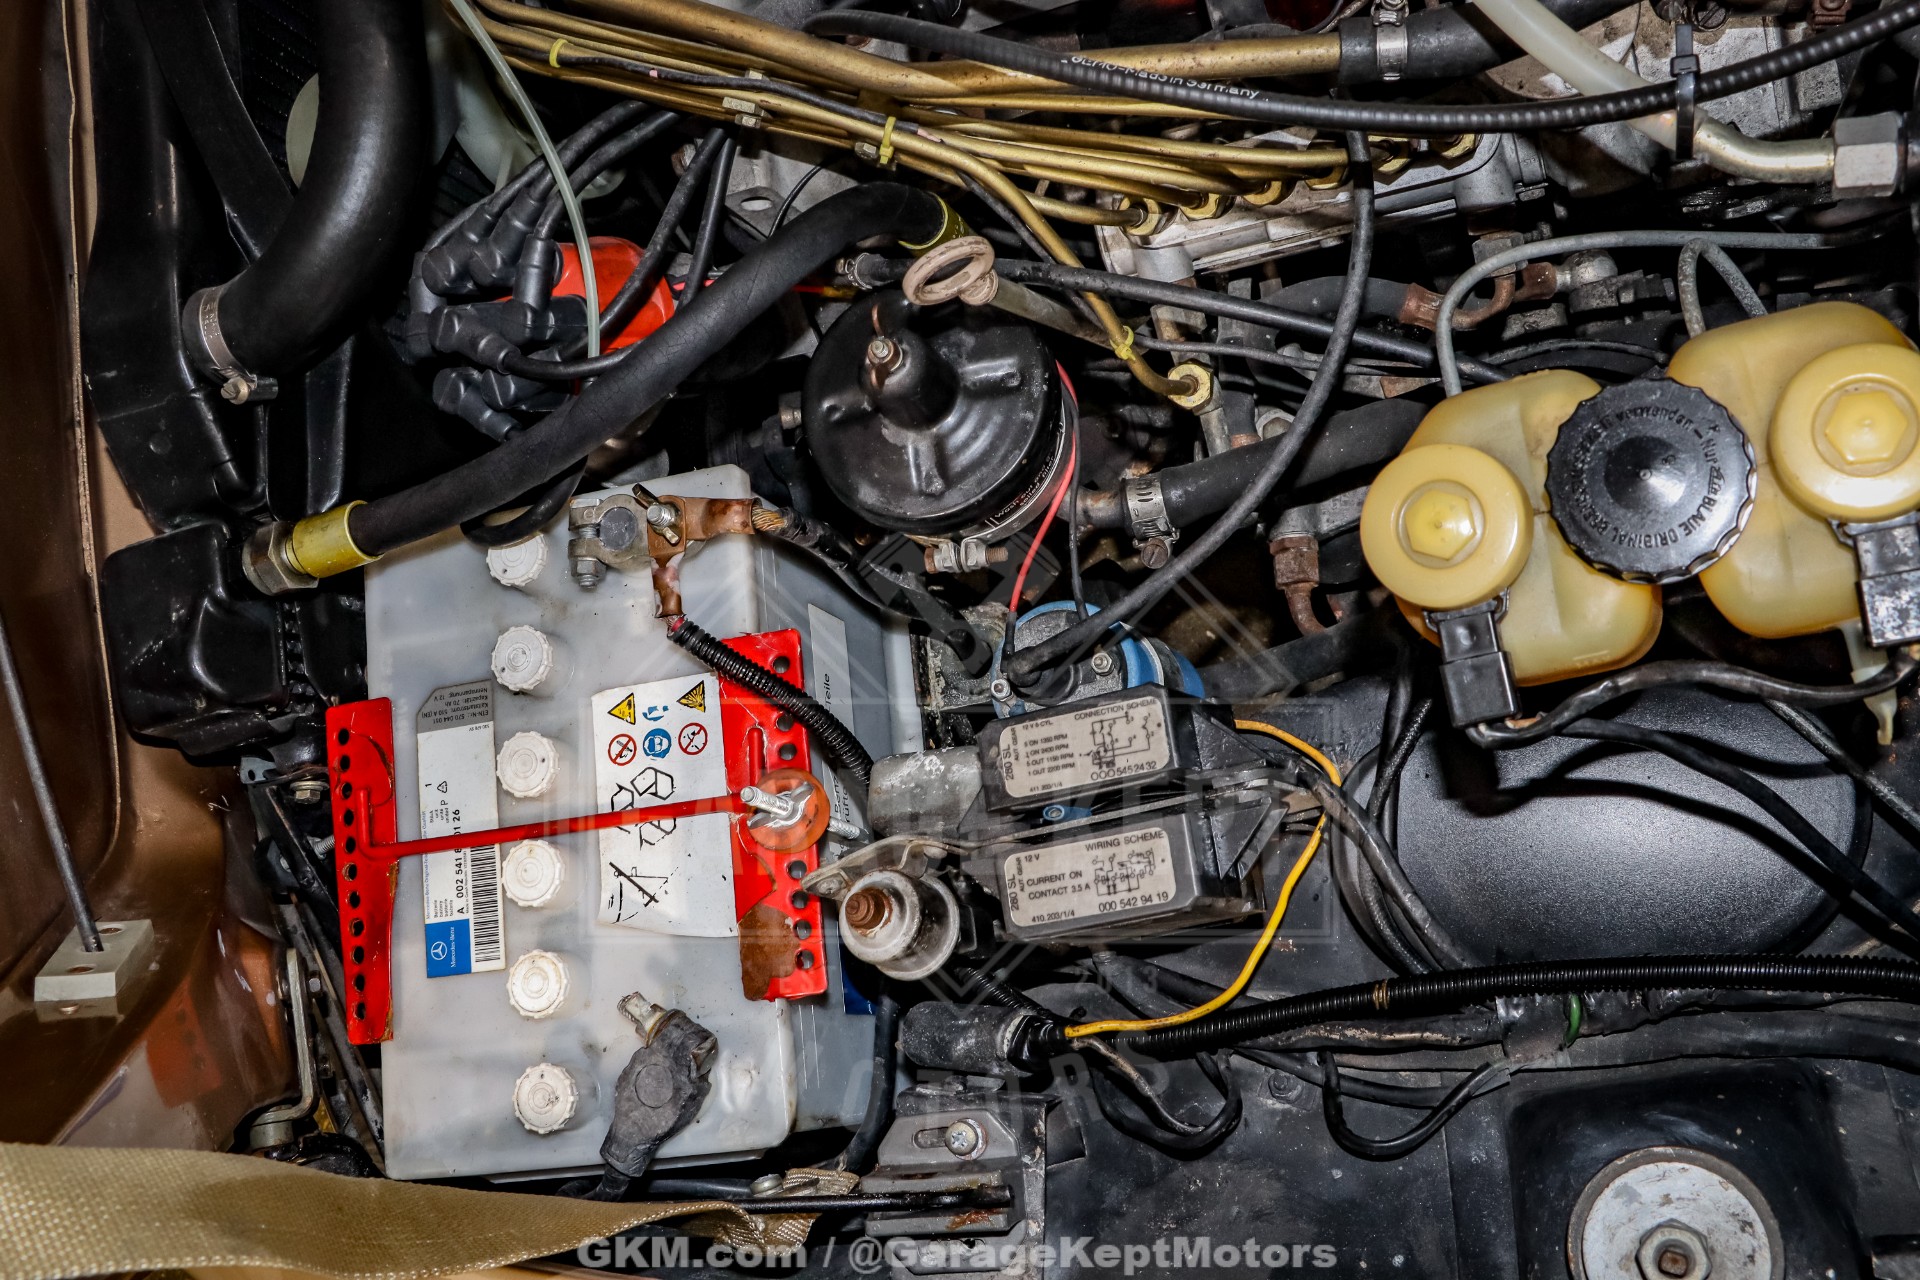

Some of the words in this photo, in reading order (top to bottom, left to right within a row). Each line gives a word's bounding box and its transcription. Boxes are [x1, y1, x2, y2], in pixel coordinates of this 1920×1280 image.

[1075, 705, 1124, 721] CONNECTION
[1126, 699, 1158, 710] SCHEME
[1054, 734, 1068, 742] RPM
[1003, 744, 1012, 759] SL
[1055, 743, 1069, 752] RPM
[1032, 758, 1045, 766] OUT
[1059, 753, 1074, 761] RPM
[1003, 762, 1014, 780] 280
[1032, 767, 1045, 776] OUT
[1061, 762, 1075, 770] RPM
[453, 809, 461, 822] 26
[1085, 839, 1121, 852] WIRING
[1124, 832, 1164, 844] SCHEME
[455, 858, 463, 875] 541
[1008, 874, 1017, 889] SL
[1026, 874, 1066, 887] CURRENT
[1069, 870, 1083, 879] ON
[456, 879, 464, 899] 002
[1029, 887, 1068, 900] CONTACT
[1072, 885, 1083, 893] 3.5
[1084, 883, 1090, 891] A
[1009, 892, 1019, 911] 280
[1099, 901, 1117, 912] 000
[1120, 897, 1138, 909] 542
[1141, 895, 1153, 905] 94
[1157, 892, 1169, 901] 19
